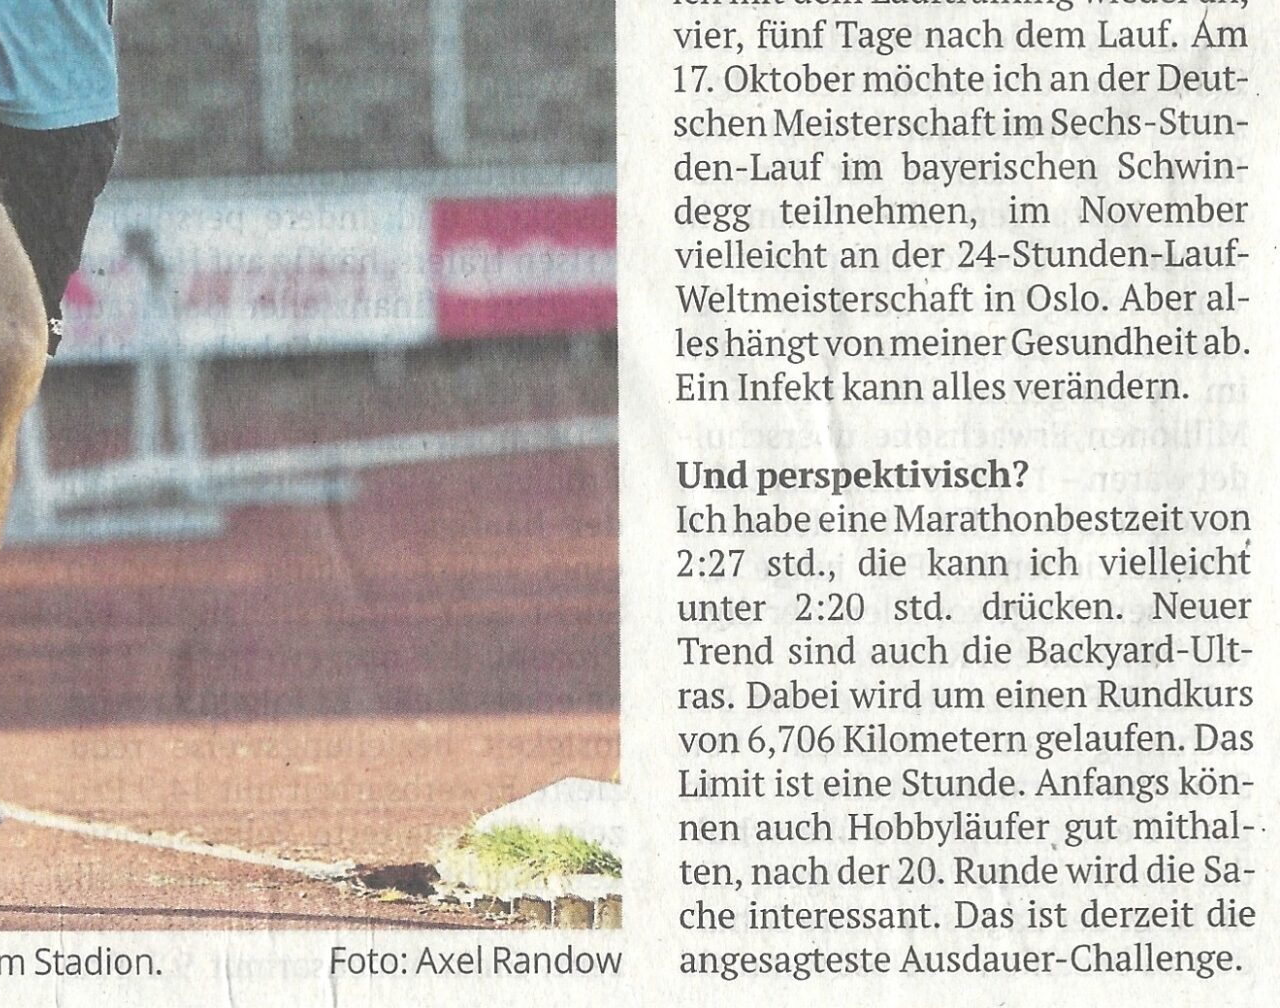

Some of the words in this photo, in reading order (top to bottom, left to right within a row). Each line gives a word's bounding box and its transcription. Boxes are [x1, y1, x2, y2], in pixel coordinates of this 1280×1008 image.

[674, 151, 824, 181] den-Lauf
[841, 151, 883, 181] im
[901, 150, 1098, 188] bayerischen
[1118, 150, 1249, 180] Schwin-
[675, 282, 973, 313] Weltmeisterschaft
[984, 283, 1016, 312] in
[1026, 282, 1108, 312] Oslo.
[1119, 281, 1197, 312] Aber
[1206, 281, 1250, 312] al-
[676, 459, 749, 489] Und
[756, 458, 1029, 496] perspektivisch?
[677, 596, 767, 622] unter
[795, 593, 865, 621] 2:20
[894, 591, 952, 621] std.
[982, 590, 1123, 621] drücken.
[1152, 591, 1252, 620] Neuer
[34, 946, 162, 976] Stadion.
[330, 946, 407, 975] Foto:
[415, 944, 482, 975] Axel
[493, 944, 622, 975] Randow
[680, 948, 891, 981] angesagteste
[899, 942, 1242, 979] Ausdauer-Challenge.
